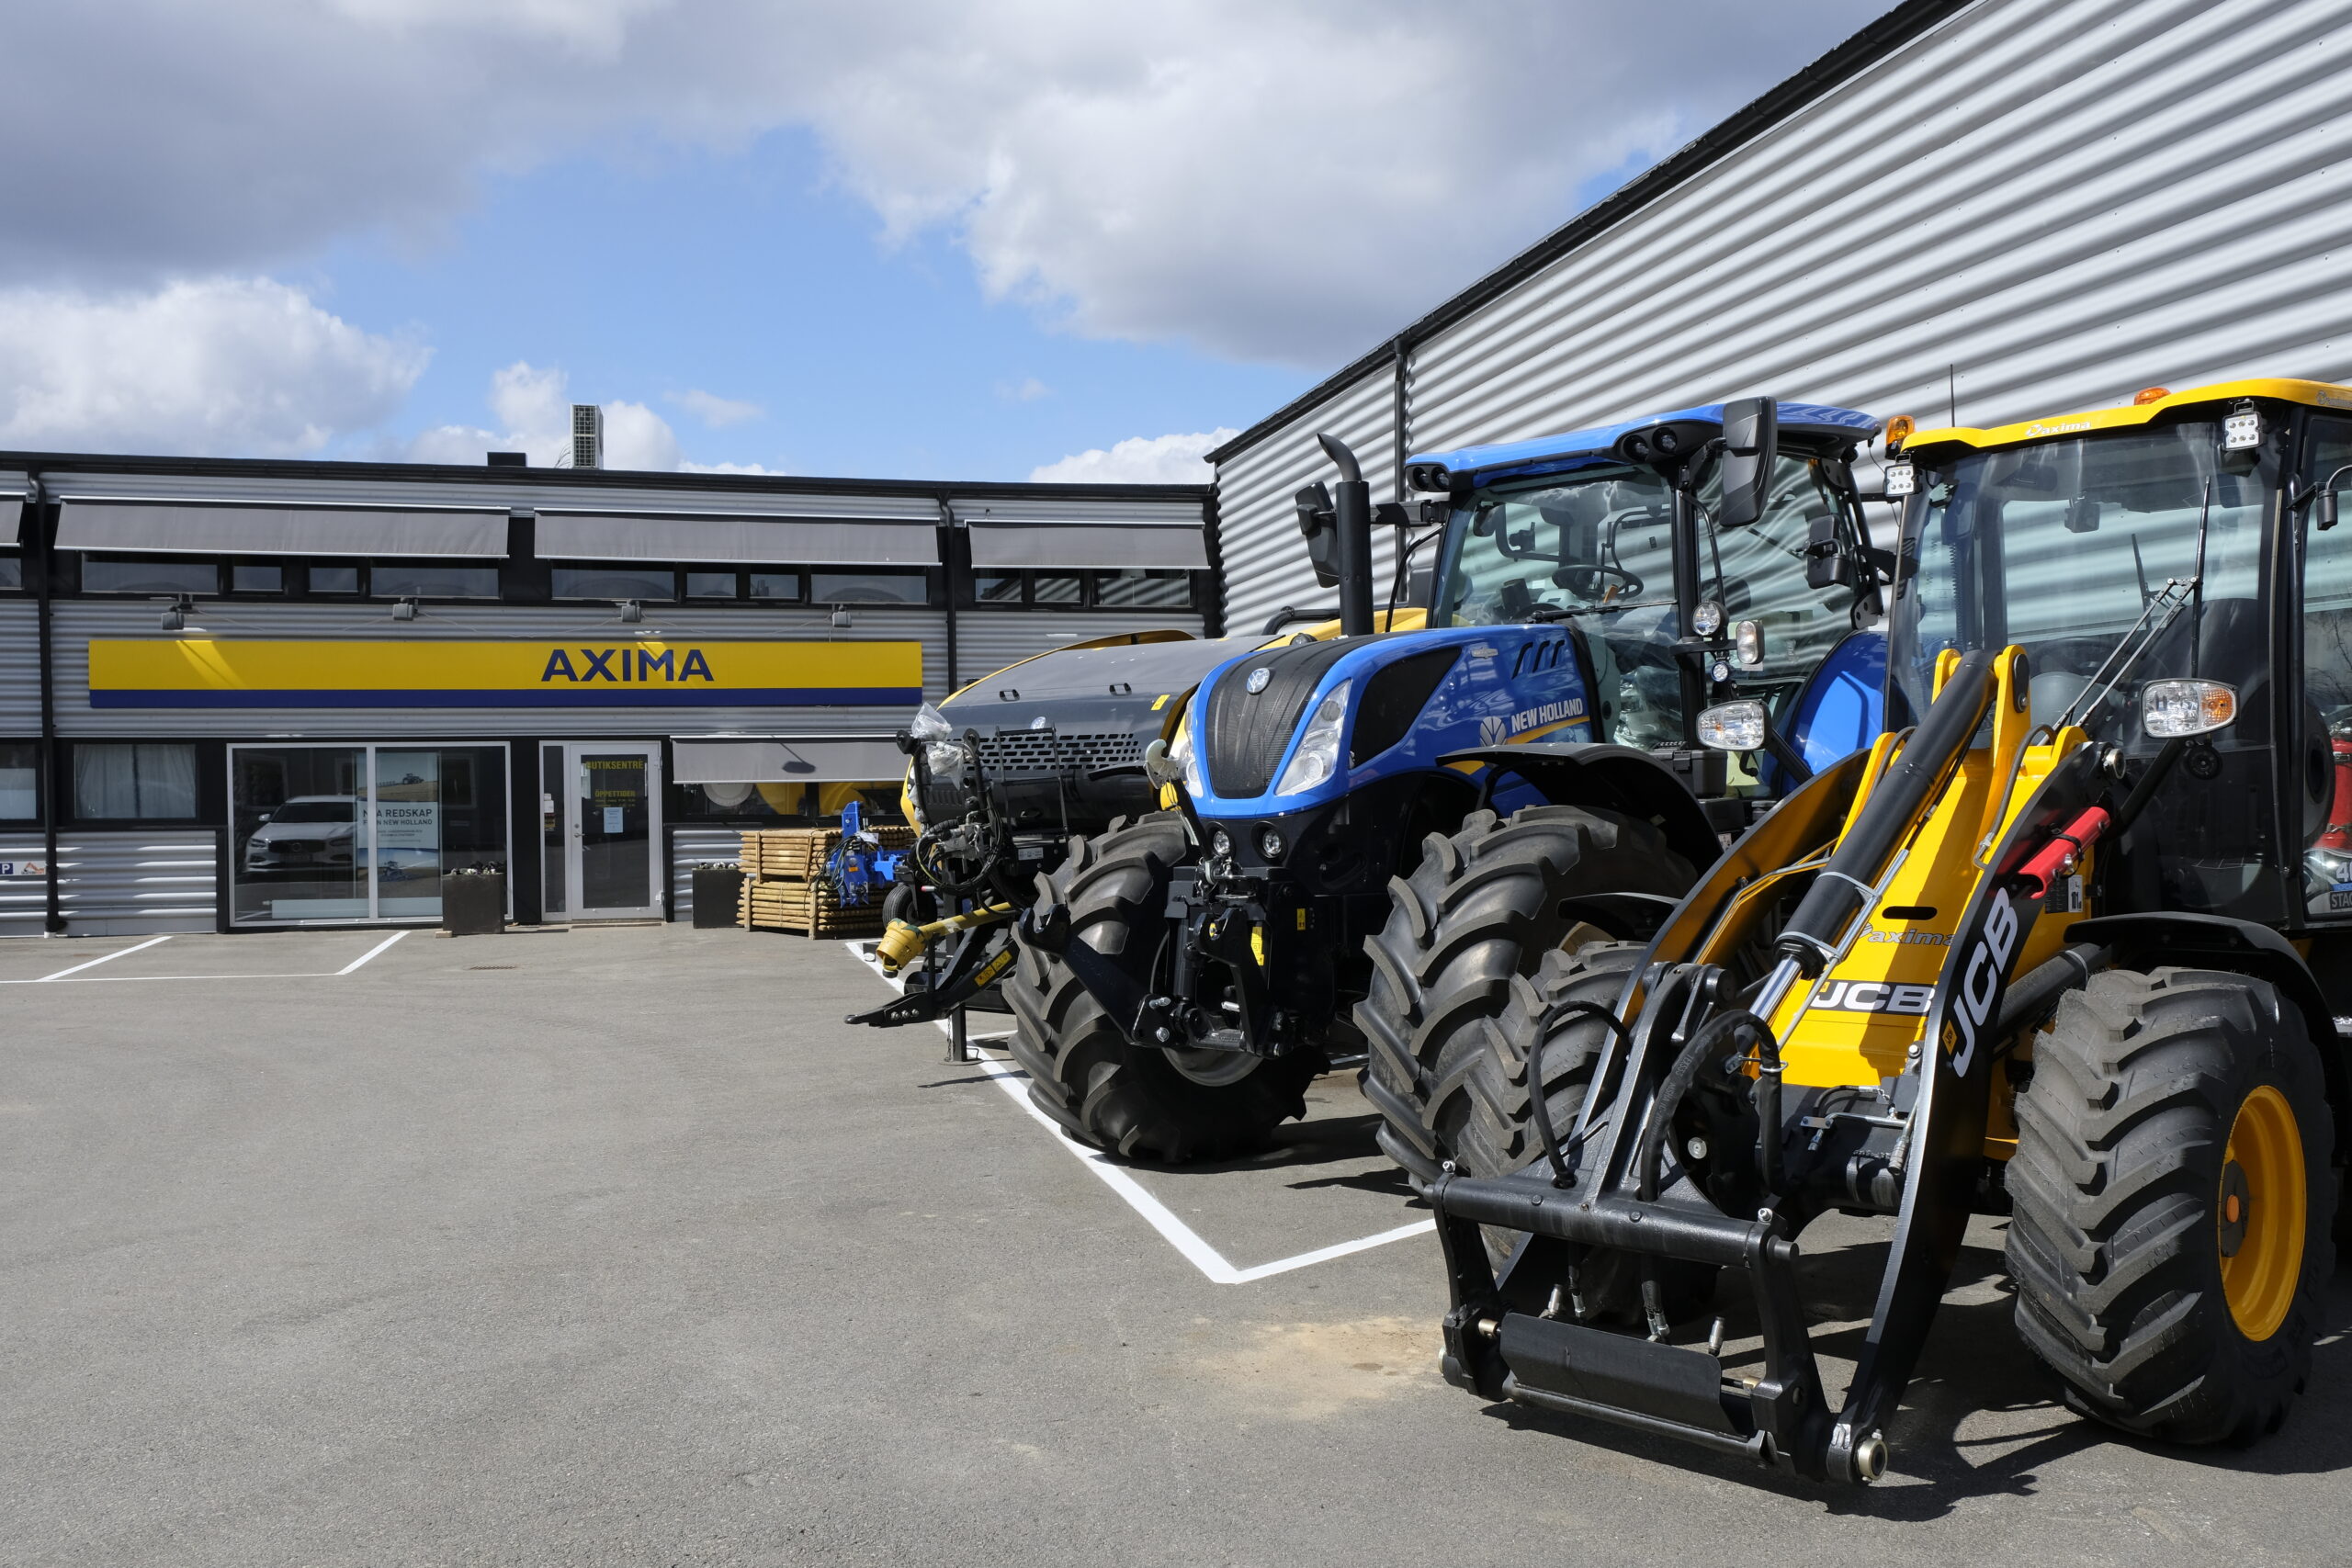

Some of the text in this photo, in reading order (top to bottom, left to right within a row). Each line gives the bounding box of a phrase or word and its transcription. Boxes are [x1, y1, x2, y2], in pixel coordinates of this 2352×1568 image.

[2041, 422, 2091, 434] axima
[540, 649, 714, 682] AXIMA
[1510, 697, 1584, 733] NEW HOLLAND
[363, 808, 433, 818] NA REDSKAP
[2, 863, 10, 874] P
[1867, 929, 1956, 947] axima
[1952, 886, 2018, 1078] JCB
[1810, 982, 1936, 1013] JCB
